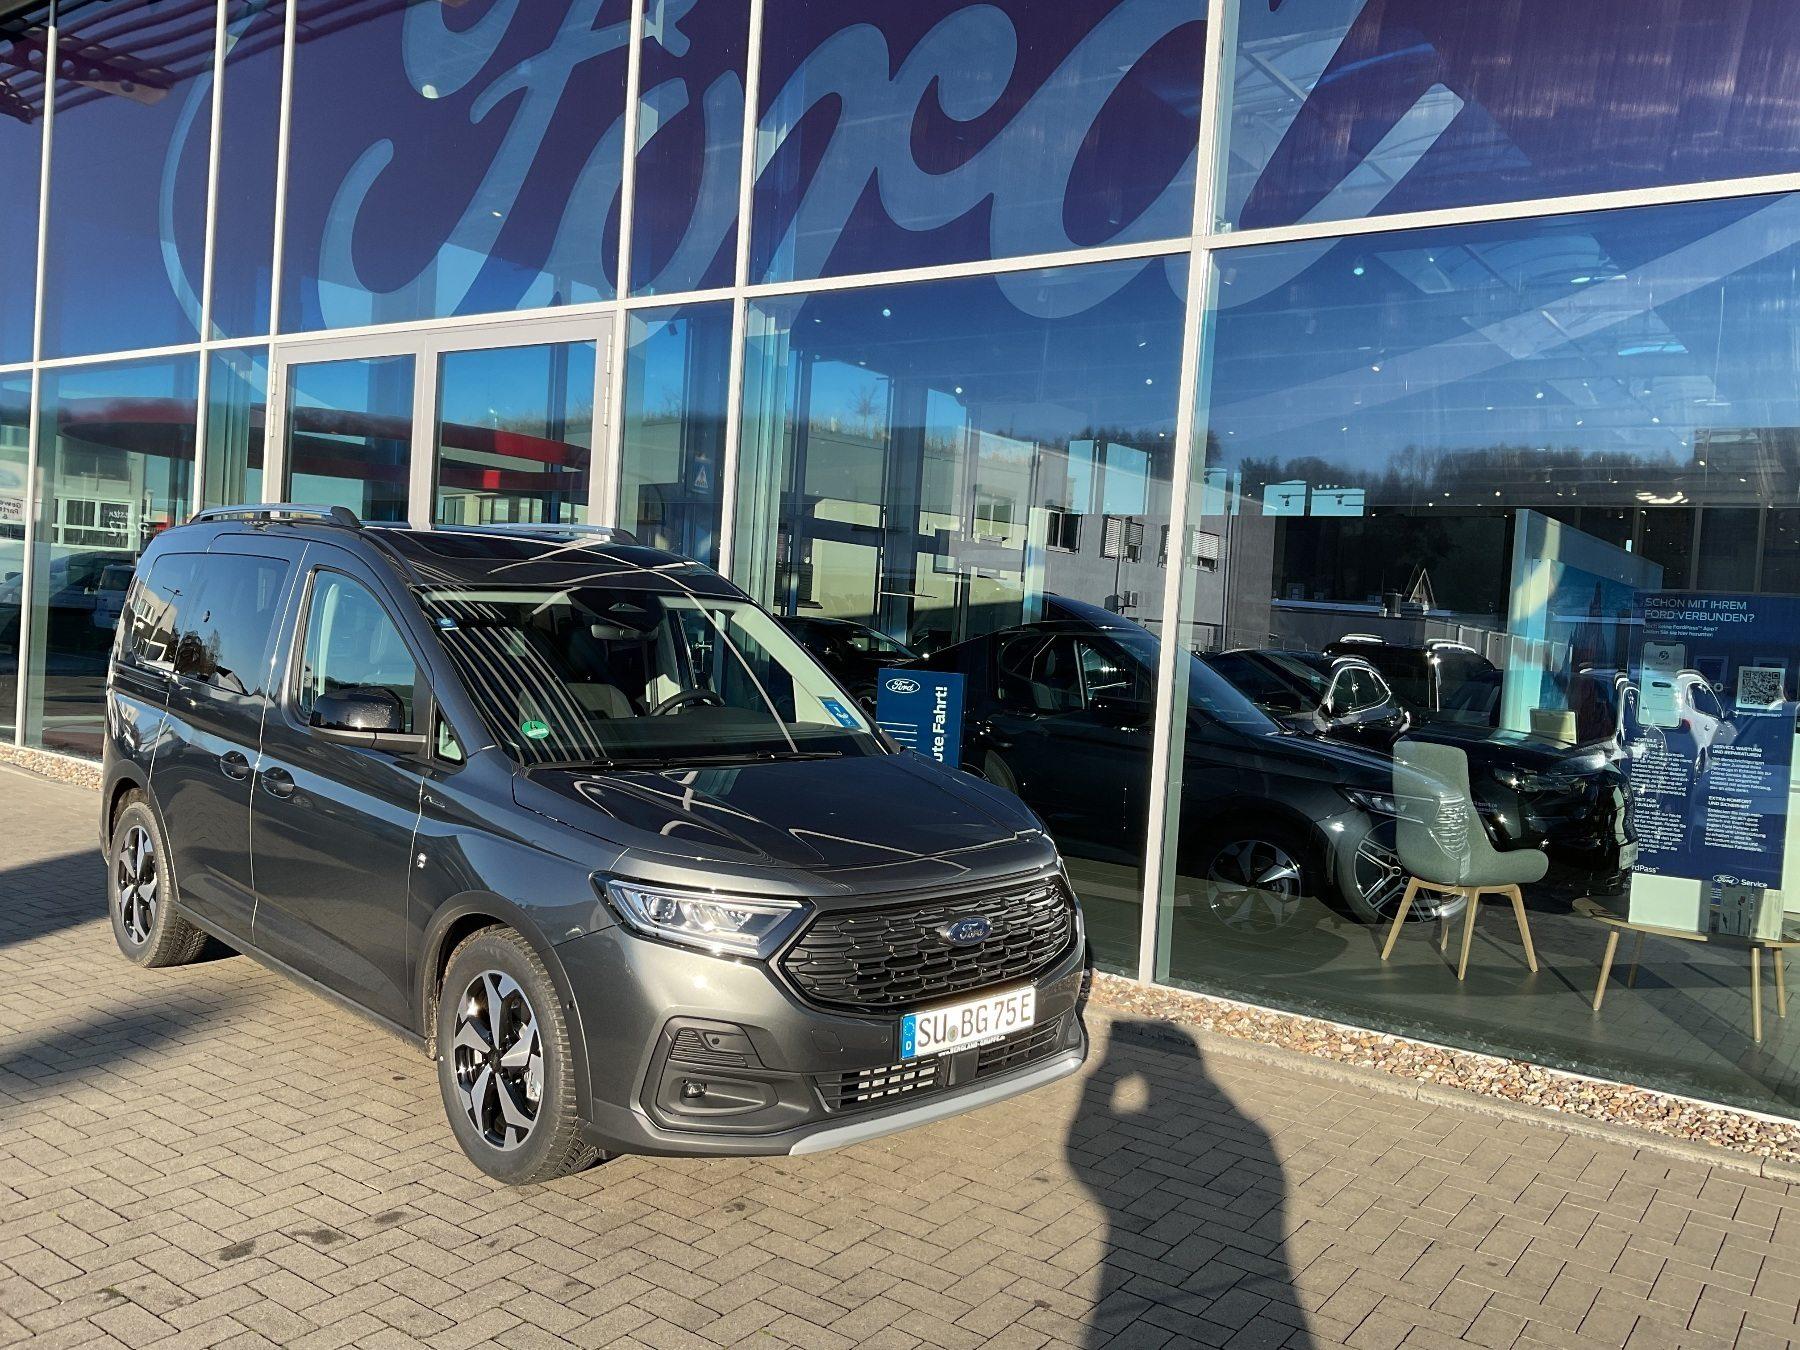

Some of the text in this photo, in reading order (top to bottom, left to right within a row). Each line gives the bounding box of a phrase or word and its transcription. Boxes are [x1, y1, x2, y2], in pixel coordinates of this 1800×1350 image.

[318, 0, 1465, 362] Ford
[1645, 598, 1746, 610] SCHON MIT IHREM
[1645, 610, 1755, 623] FORD VERBUNDEN?
[891, 679, 915, 692] Ford
[931, 686, 948, 762] ute Fahrt!
[1741, 879, 1768, 888] Service
[959, 922, 985, 940] Ford
[917, 1014, 948, 1048] SU
[960, 1004, 988, 1038] BG
[906, 1042, 912, 1051] D
